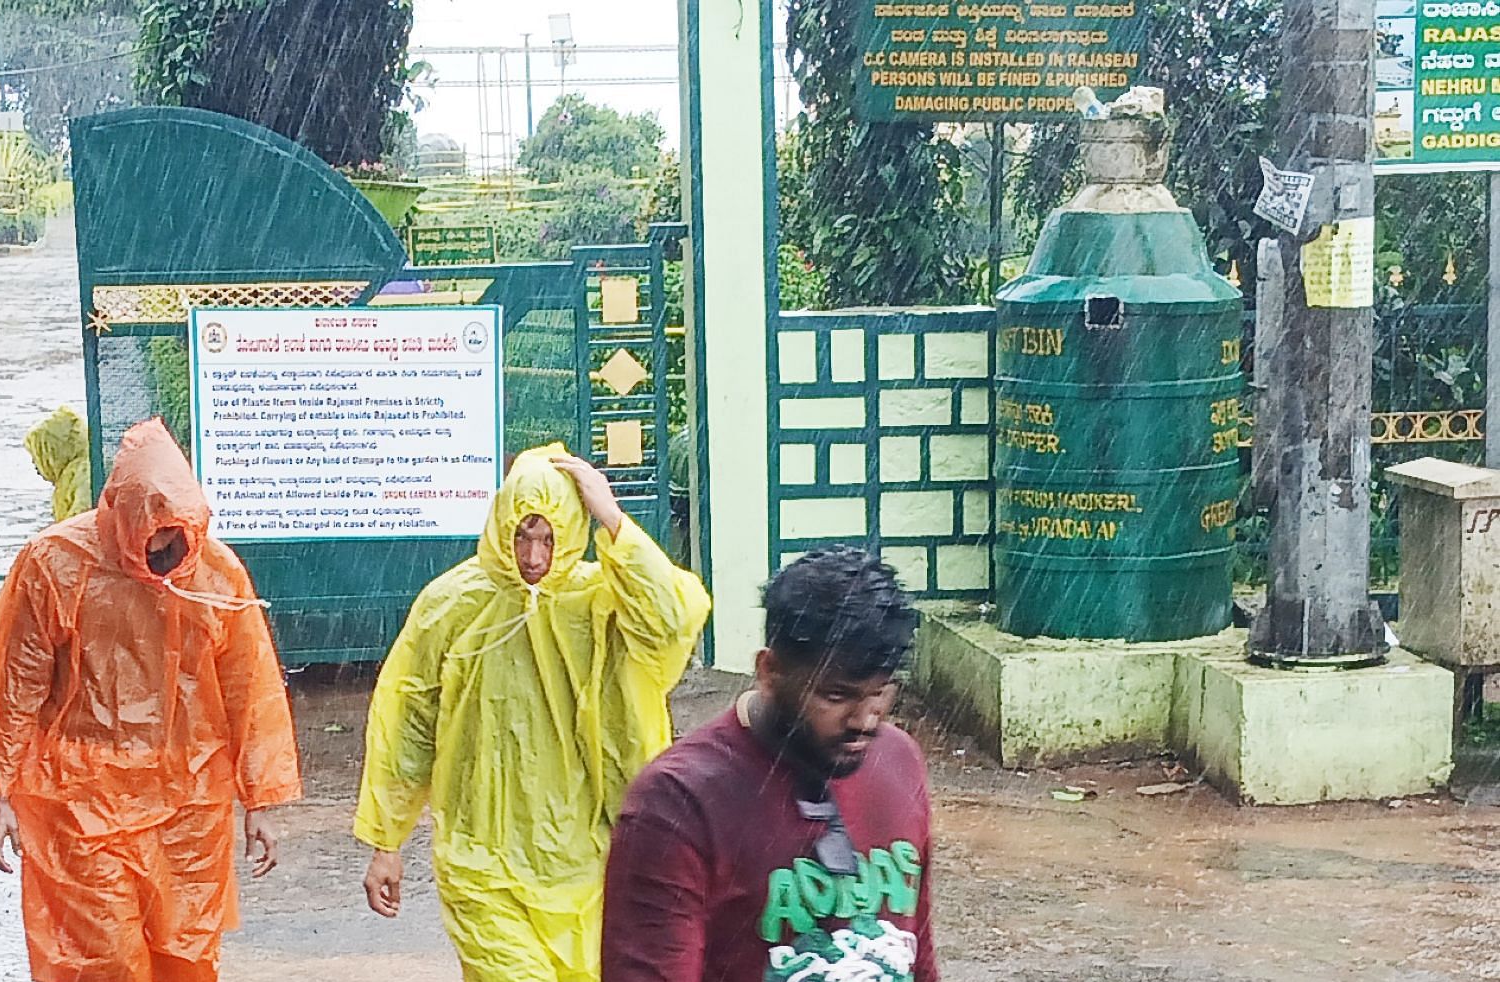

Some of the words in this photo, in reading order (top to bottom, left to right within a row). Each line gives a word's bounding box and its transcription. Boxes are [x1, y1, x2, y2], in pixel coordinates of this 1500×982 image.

[889, 53, 947, 67] CAMERA
[951, 53, 964, 66] IS
[969, 53, 1043, 67] INSTALLED
[1049, 53, 1062, 66] IN
[1068, 53, 1138, 68] RAJASEAT
[871, 72, 936, 86] PERSONS
[941, 72, 972, 86] WILL
[977, 72, 995, 86] BE
[1000, 72, 1041, 86] FINED
[1422, 78, 1486, 95] NEHRU
[895, 96, 969, 111] DAMAGING
[972, 96, 1024, 111] PUBLIC
[1022, 327, 1063, 355] BIN
[213, 398, 228, 406] Use
[231, 398, 239, 406] of
[242, 397, 271, 406] Plastic
[273, 398, 296, 406] Items
[365, 397, 402, 406] Premises
[415, 397, 444, 407] Strictly
[261, 411, 296, 422] Carrying
[298, 411, 307, 420] of
[422, 411, 466, 419] Prohibited.
[216, 457, 249, 467] Plucking
[251, 457, 259, 465] of
[262, 457, 292, 465] Flowers
[352, 456, 384, 466] Damage
[412, 455, 438, 466] garden
[217, 491, 231, 499] Pet
[234, 491, 265, 499] Animal
[286, 490, 321, 498] Allowed
[293, 520, 329, 531] Charged
[380, 521, 395, 530] any
